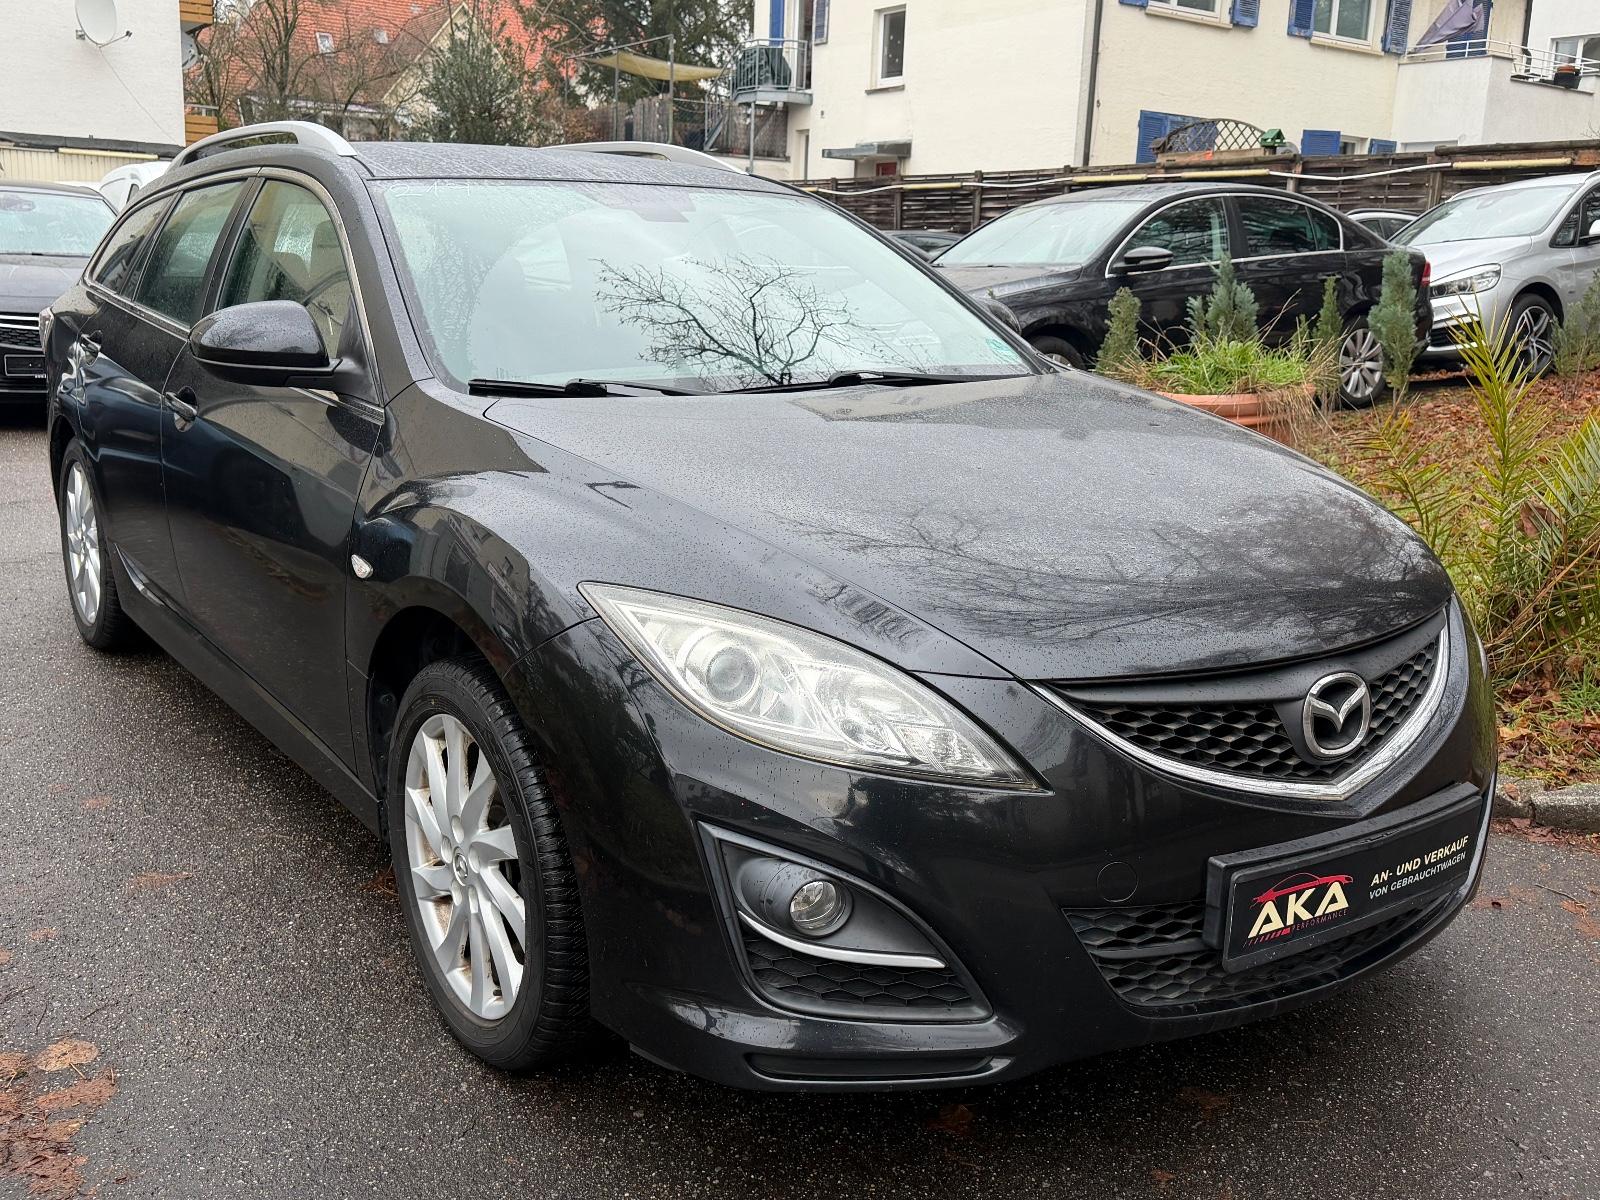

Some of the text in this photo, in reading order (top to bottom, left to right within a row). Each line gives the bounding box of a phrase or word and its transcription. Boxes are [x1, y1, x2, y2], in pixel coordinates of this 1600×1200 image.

[1369, 851, 1467, 900] VON GEBRAUCHTWAGEN
[1370, 835, 1469, 887] AN- UND VERKAUF
[1248, 881, 1349, 939] AKA
[1291, 908, 1348, 931] PERFORMANCE
